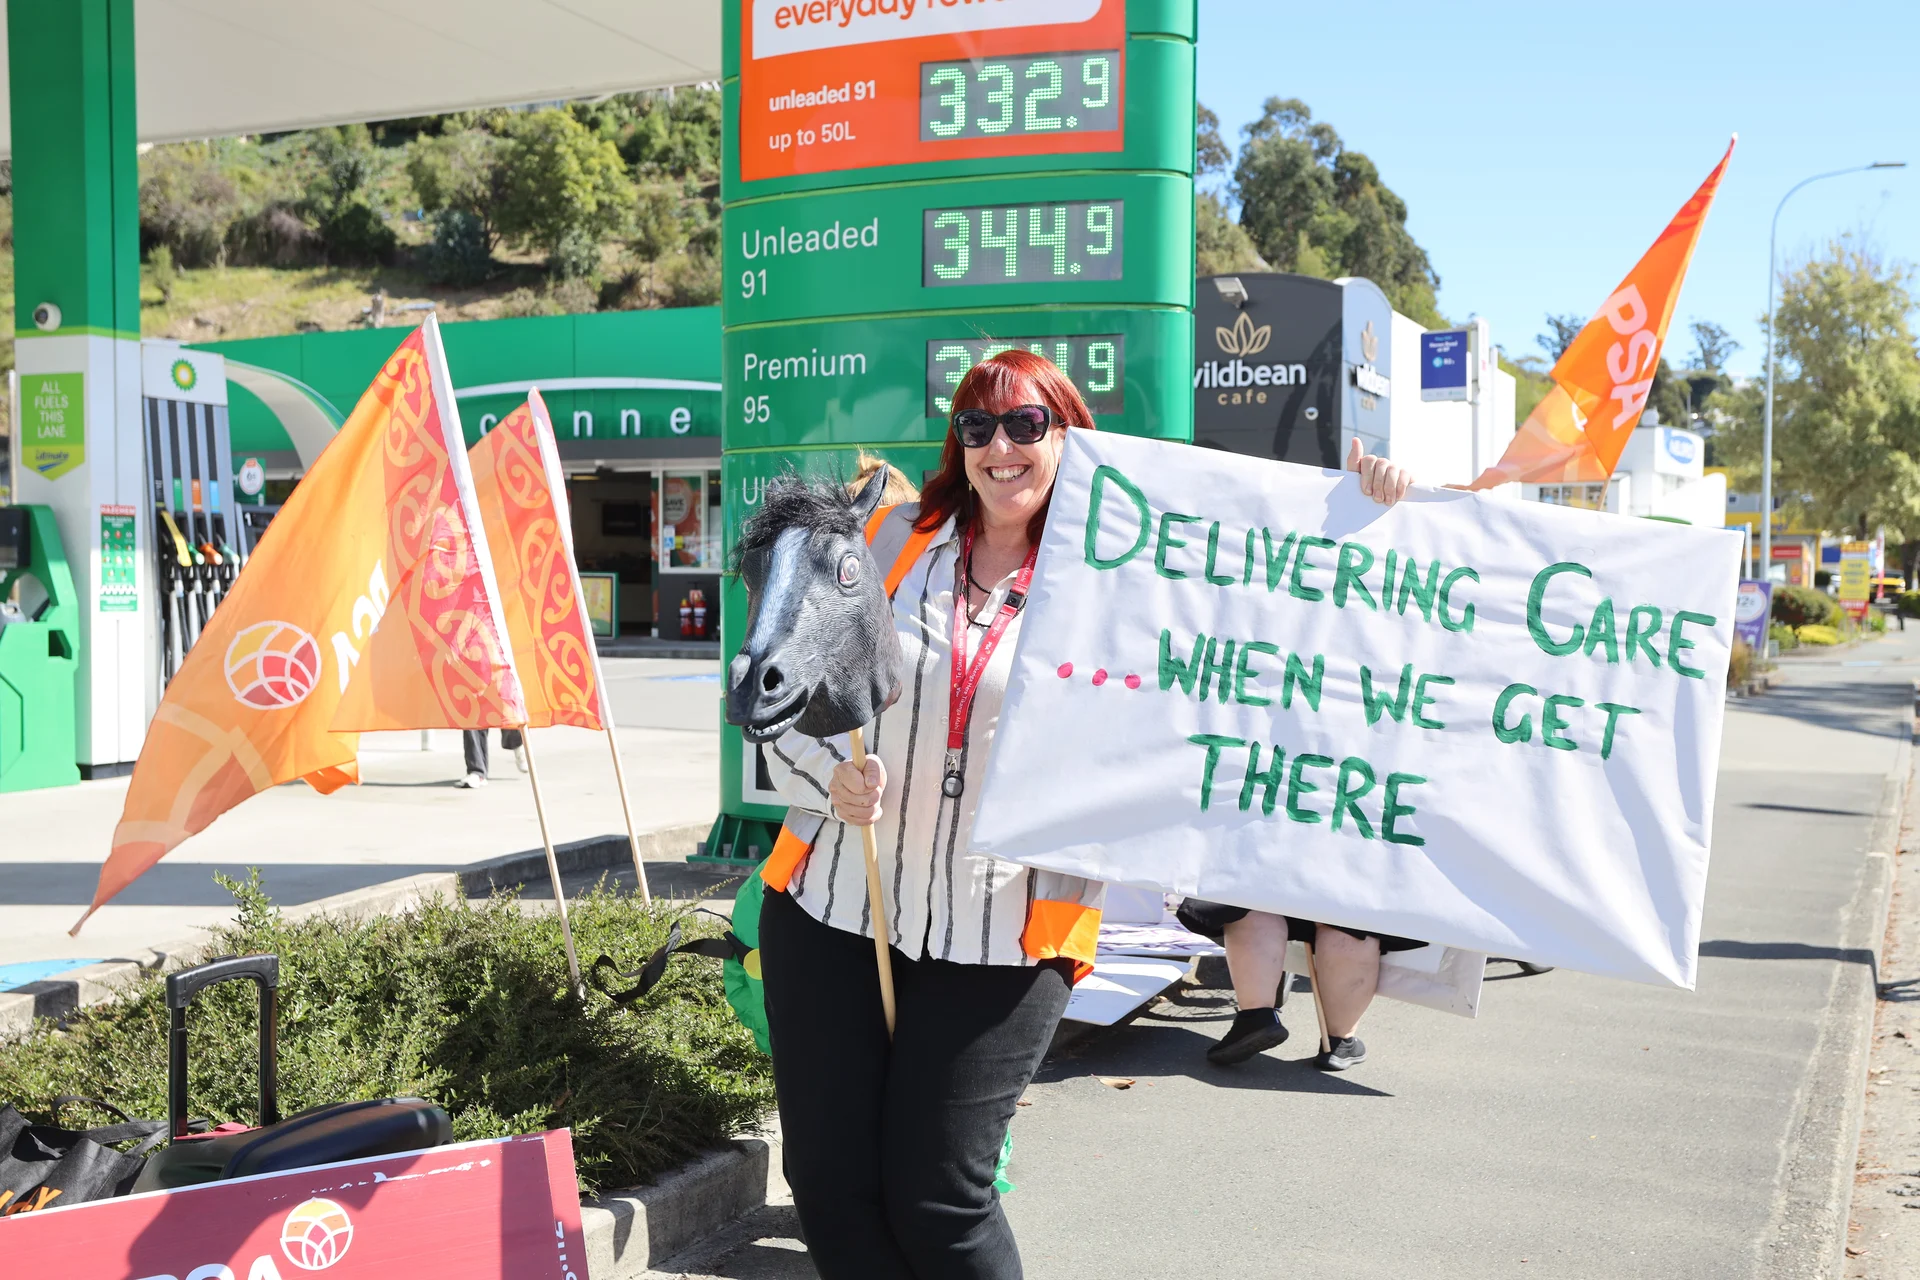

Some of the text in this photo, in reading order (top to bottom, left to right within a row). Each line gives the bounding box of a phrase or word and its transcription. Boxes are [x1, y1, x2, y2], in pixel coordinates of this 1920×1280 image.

[775, 0, 916, 29] everyday
[769, 80, 876, 111] unleaded 91
[930, 57, 1110, 136] 332.9
[769, 122, 856, 152] up to 50L
[742, 218, 879, 260] Unleaded
[933, 205, 1113, 280] 344.9
[741, 269, 767, 299] 91
[744, 348, 866, 381] Premium
[1591, 283, 1657, 431] PSA
[35, 395, 69, 409] FUELS
[41, 380, 61, 394] ALL
[1218, 389, 1268, 406] cafe
[39, 409, 64, 423] THIS
[743, 395, 770, 424] 95
[37, 424, 66, 438] LANE
[1084, 464, 1717, 679] DELIVERING CARE
[1158, 628, 1325, 712] WHEN
[1360, 663, 1455, 729] WE
[1492, 682, 1642, 760] GET
[1186, 734, 1428, 846] THERE
